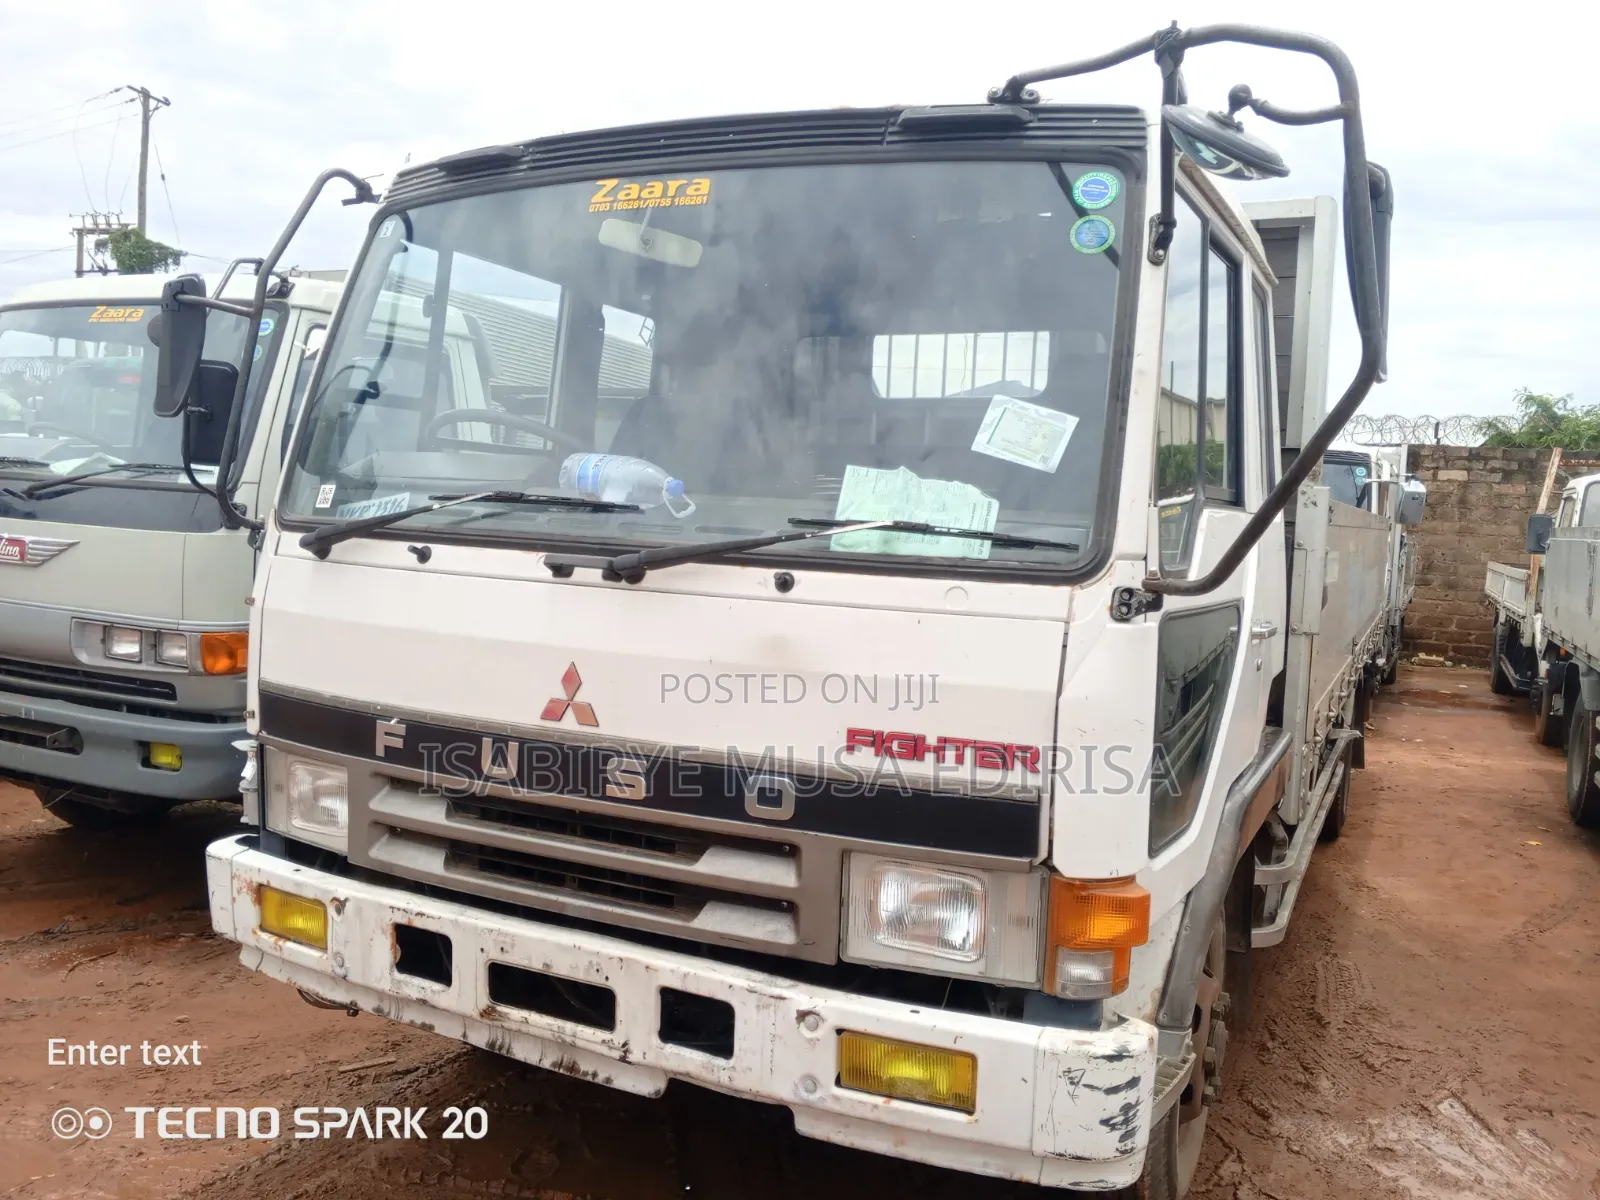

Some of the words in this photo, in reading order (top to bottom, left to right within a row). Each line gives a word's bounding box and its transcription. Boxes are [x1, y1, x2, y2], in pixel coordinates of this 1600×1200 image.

[591, 177, 711, 203] Zaara
[589, 202, 610, 213] 0703
[91, 305, 144, 318] Zaara
[846, 727, 1041, 774] FIGHTER
[375, 718, 797, 821] FUSO
